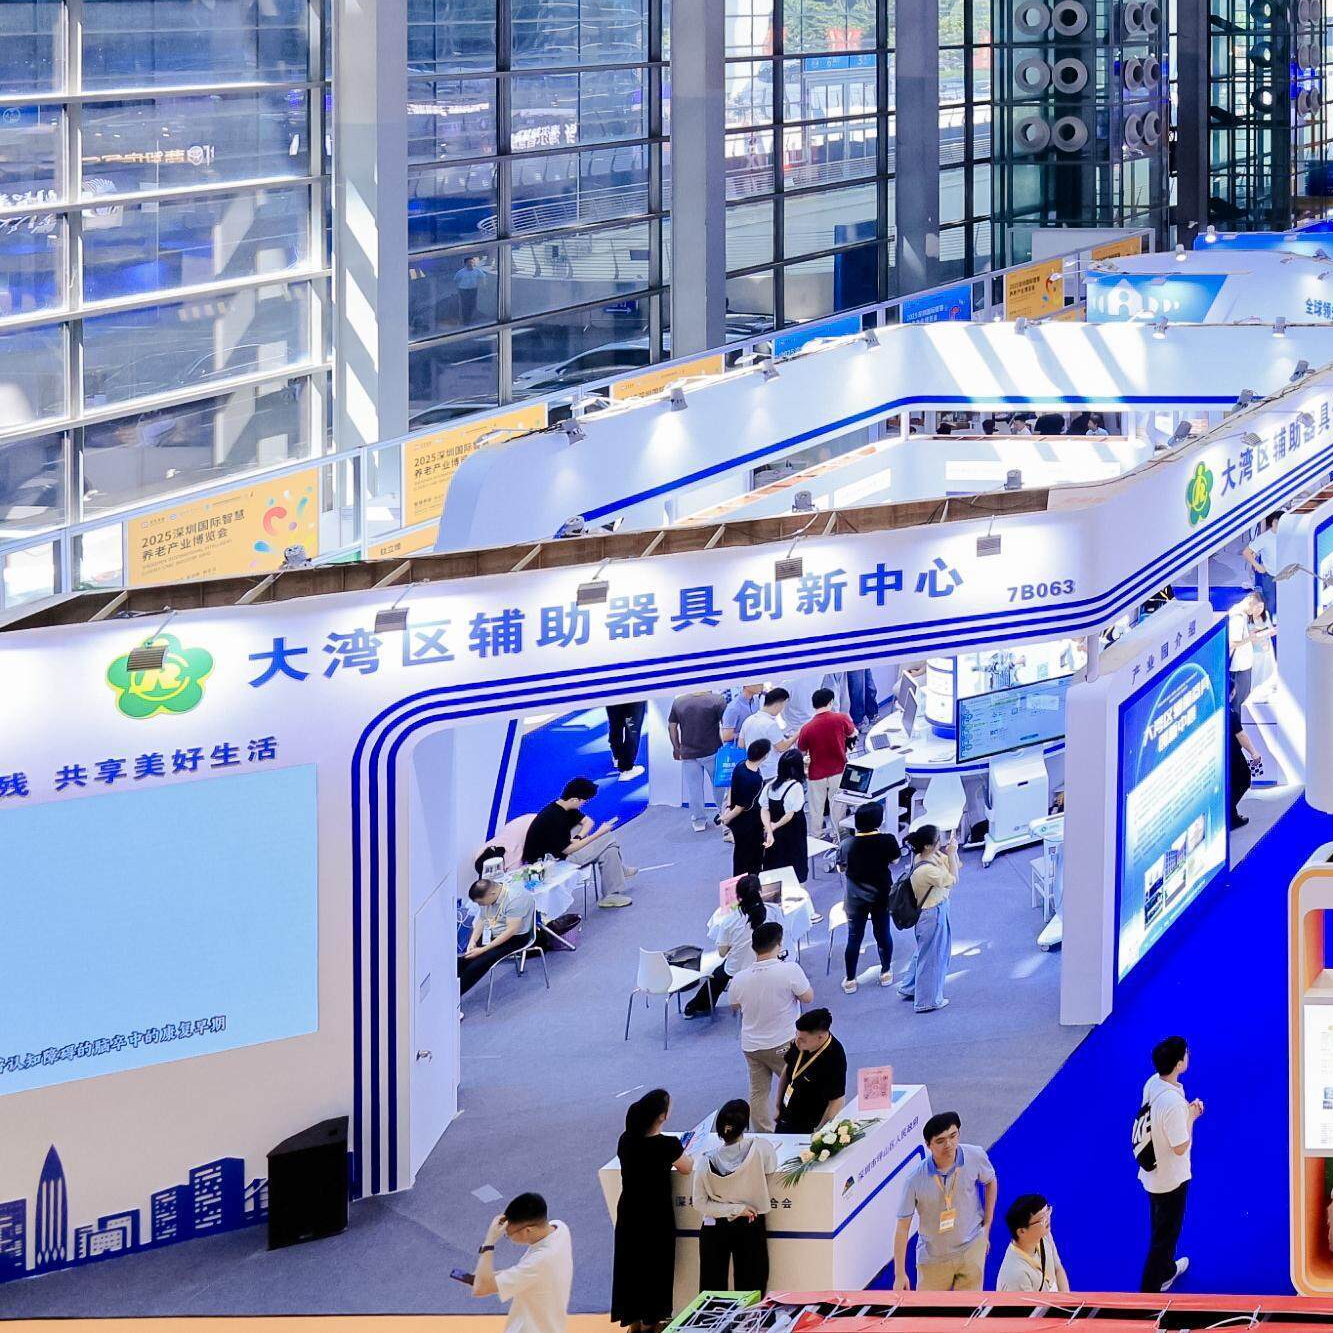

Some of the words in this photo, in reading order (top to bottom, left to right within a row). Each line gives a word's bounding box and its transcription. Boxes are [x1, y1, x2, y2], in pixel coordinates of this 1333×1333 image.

[141, 508, 246, 549] 2025深圳国际智慧
[142, 527, 229, 562] 养老产业博览会
[1006, 578, 1077, 604] 7B063
[248, 556, 964, 688] 大湾区辅助器具创新中心
[55, 735, 279, 791] 共享美好生活
